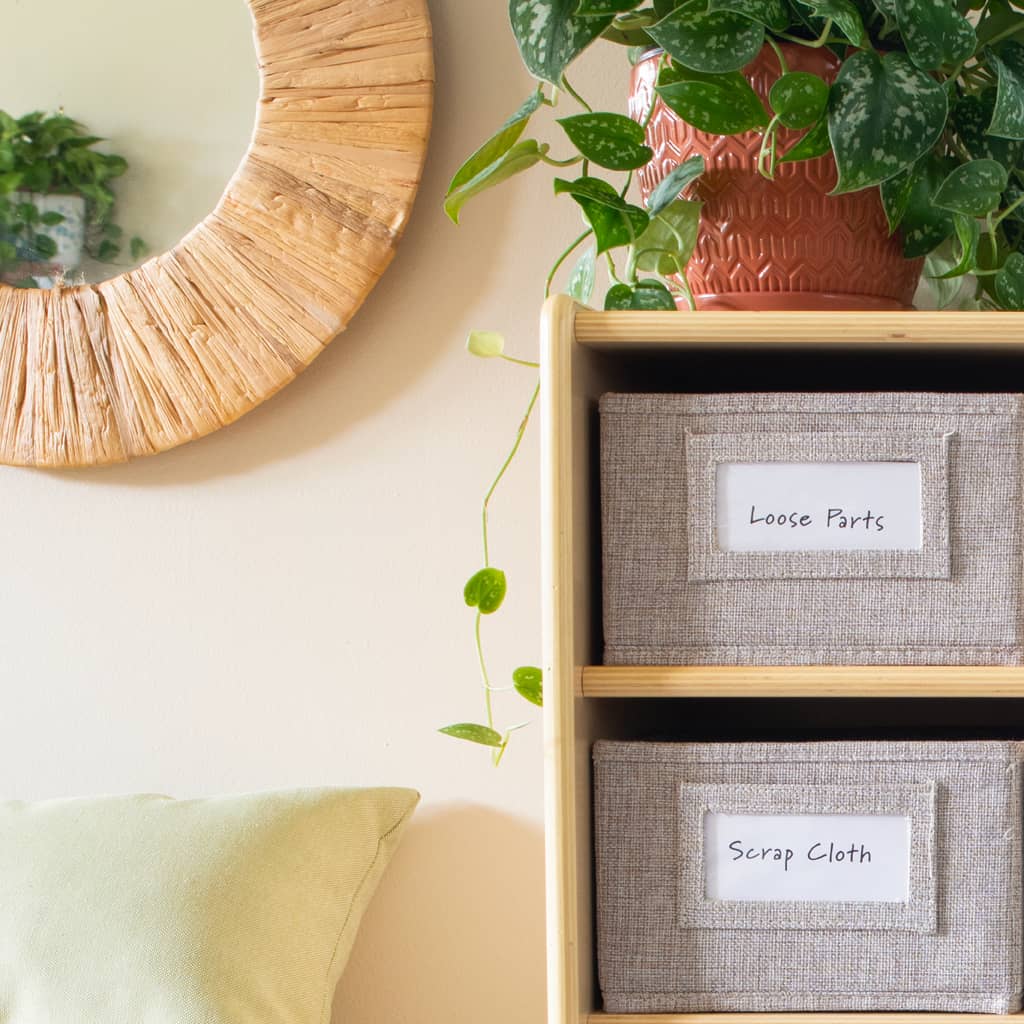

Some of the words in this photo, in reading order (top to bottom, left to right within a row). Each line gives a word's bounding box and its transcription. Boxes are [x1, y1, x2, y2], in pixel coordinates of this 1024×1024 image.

[749, 504, 812, 529] Loose
[826, 508, 885, 532] Parts
[728, 839, 795, 872] Scrap
[806, 842, 873, 864] Cloth
